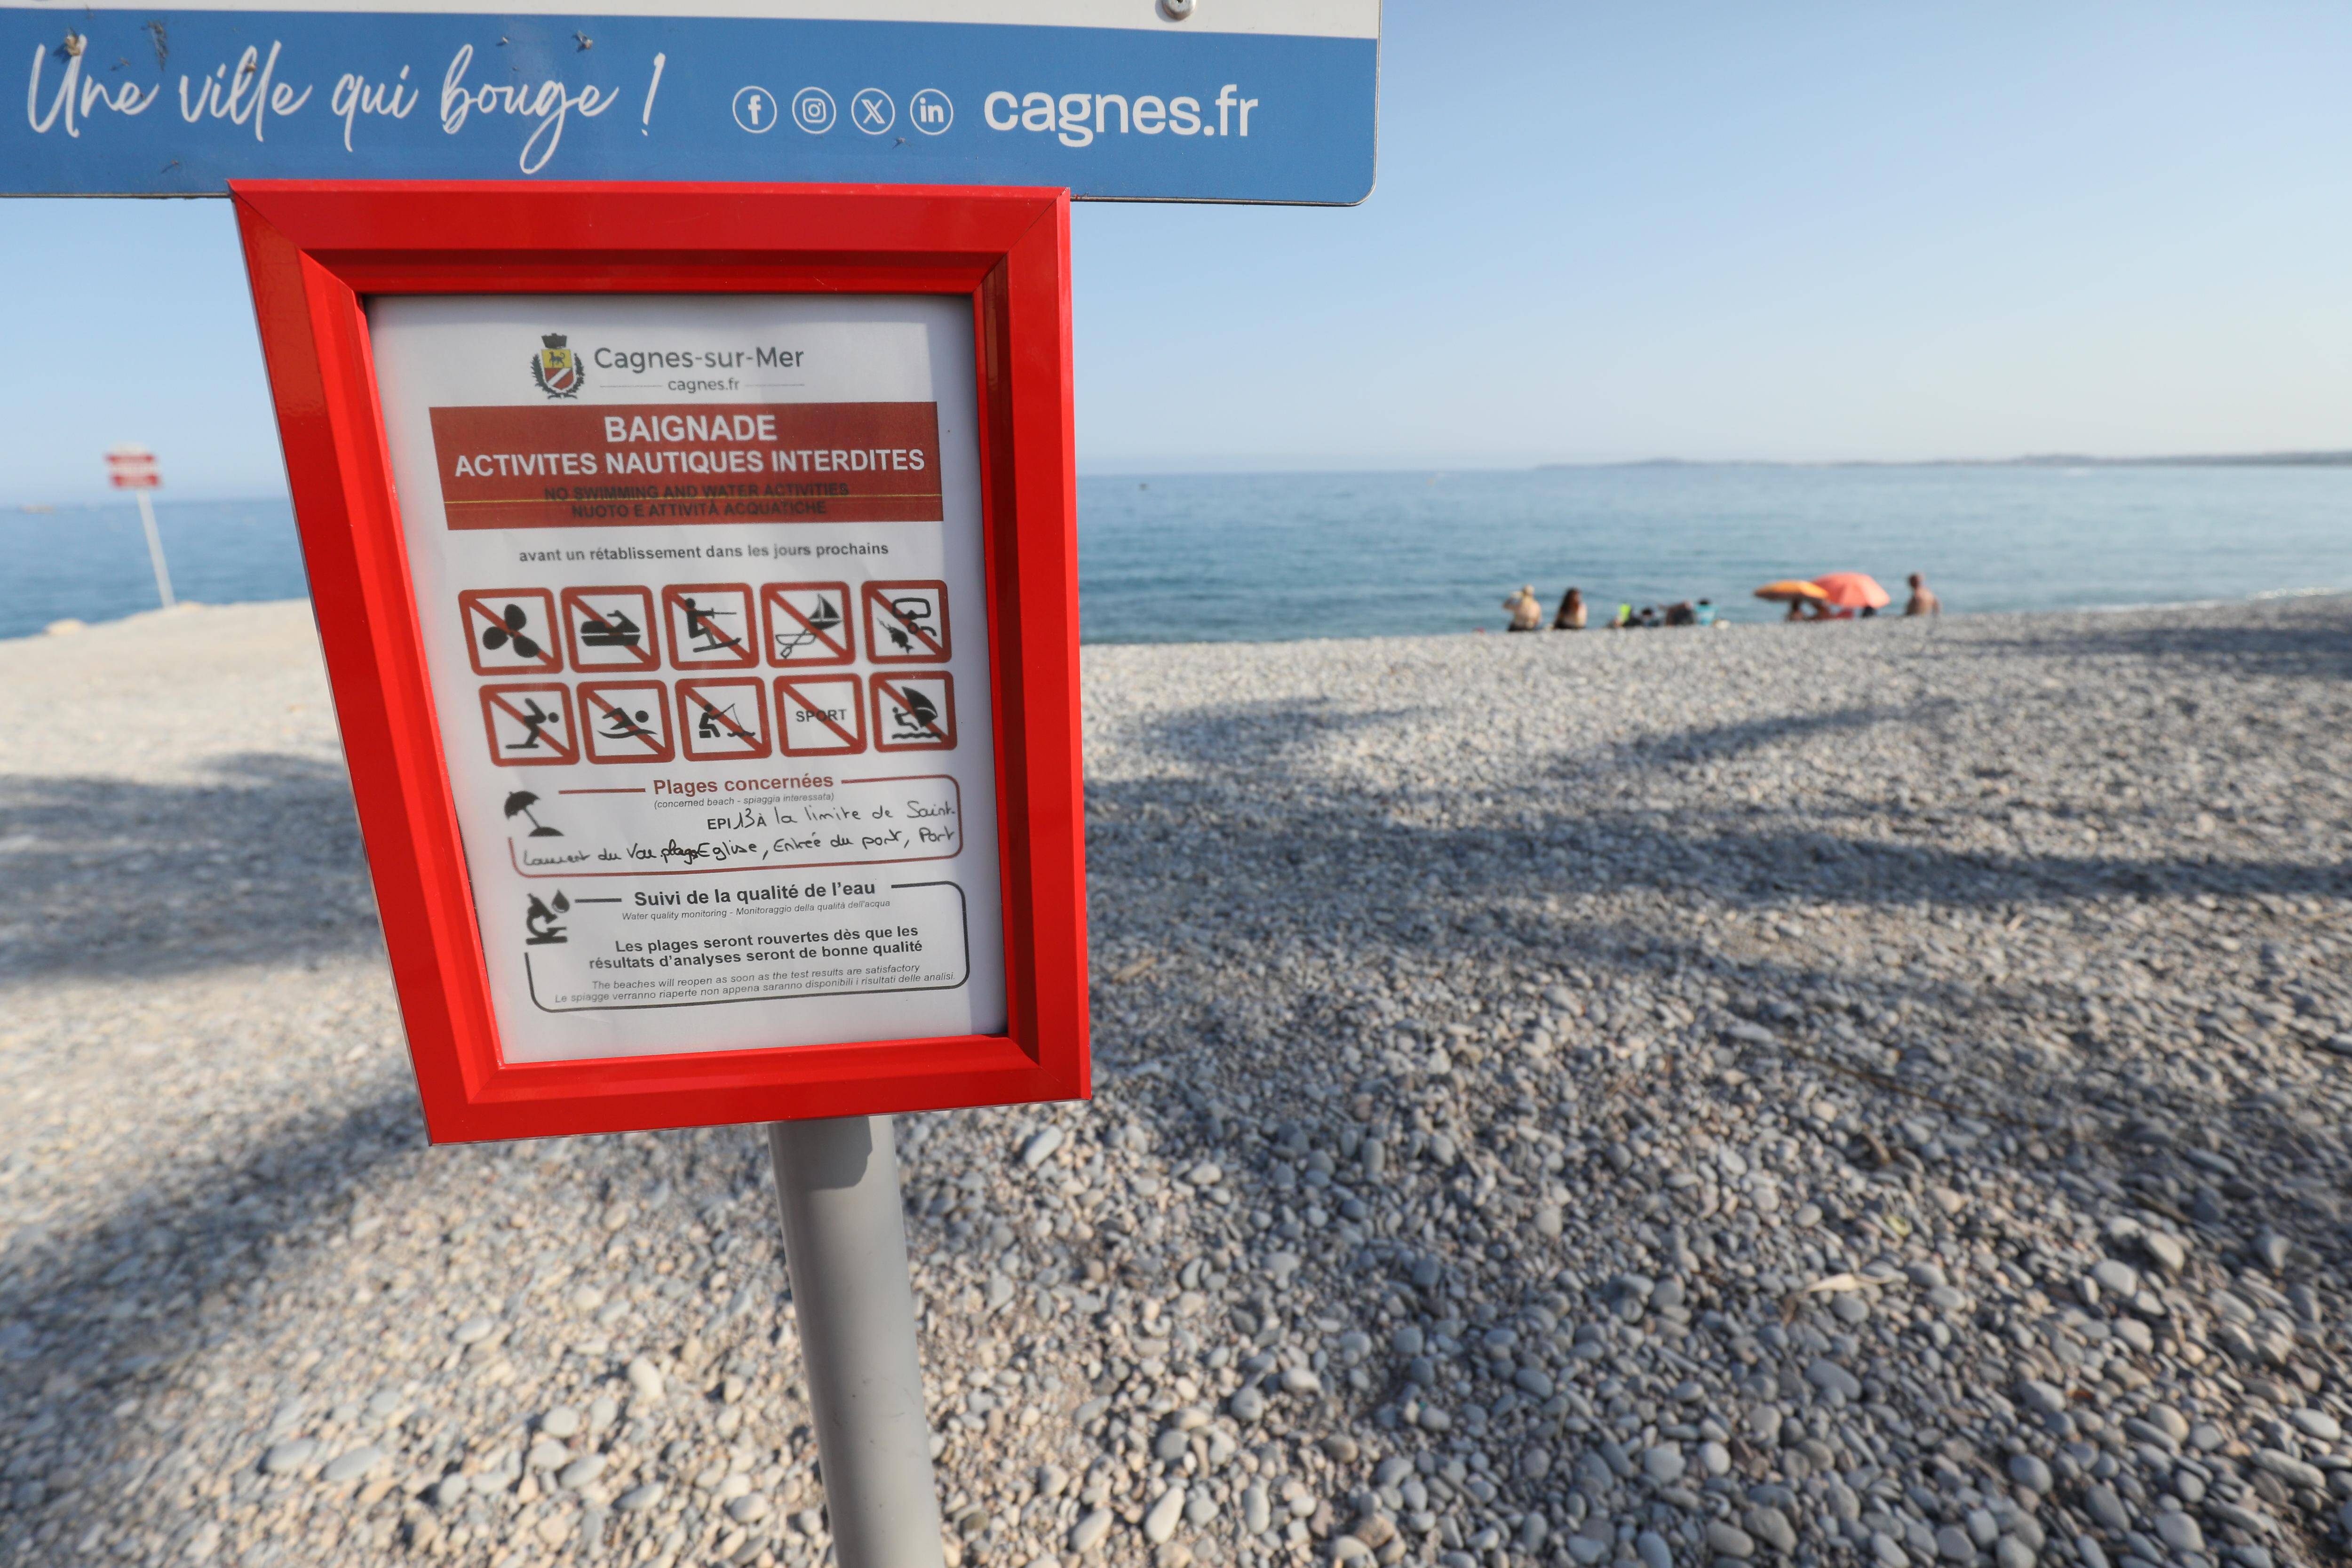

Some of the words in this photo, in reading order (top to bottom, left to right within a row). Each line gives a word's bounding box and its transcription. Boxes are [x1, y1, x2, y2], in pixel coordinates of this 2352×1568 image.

[28, 34, 159, 137] Une
[181, 40, 312, 142] ville
[332, 65, 419, 151] qui
[441, 44, 619, 174] bouge
[641, 52, 666, 136] !
[984, 84, 1258, 148] cagnes.fr
[594, 346, 804, 374] Cagnes-sur-Mer
[668, 378, 740, 394] cagnes.fr
[604, 415, 777, 443] BAIGNADE
[455, 453, 596, 478] ACTIVITES
[607, 450, 763, 475] NAUTIQUES
[772, 449, 924, 472] INTERDITES
[544, 486, 568, 500] NO
[573, 485, 659, 500] SWIMMING
[664, 485, 698, 498] AND
[704, 484, 759, 497] WATER
[764, 483, 850, 496] ACTIVITIES
[572, 504, 628, 517] NUOTO
[635, 504, 644, 517] E
[724, 501, 826, 515] ACQUATICHE
[519, 550, 562, 562] avant
[567, 551, 584, 561] un
[590, 547, 701, 560] rétablissement
[706, 545, 743, 558] dans
[748, 545, 769, 557] les
[774, 545, 810, 559] jours
[816, 543, 889, 558] prochains
[795, 708, 847, 722] SPORT
[653, 779, 718, 797] Plages
[724, 773, 834, 791] concernées
[707, 797, 734, 806] beach
[743, 795, 780, 805] spiaggia
[783, 793, 834, 802] interessata)
[707, 817, 731, 829] EPI
[774, 806, 797, 824] la
[804, 805, 861, 821] limite
[872, 805, 893, 818] de
[830, 834, 854, 847] du
[919, 826, 955, 843] Port
[635, 891, 681, 906] Suivi
[687, 891, 709, 904] de
[715, 889, 731, 903] la
[737, 884, 799, 905] qualité
[805, 883, 826, 898] de
[651, 910, 679, 921] quality
[682, 909, 727, 918] monitoring
[736, 905, 791, 915] Monitoraggio
[795, 904, 814, 912] della
[818, 902, 845, 911] qualità
[615, 941, 643, 952] Les
[648, 939, 699, 954] plages
[704, 935, 753, 948] seront
[757, 931, 829, 945] rouvertes
[834, 929, 860, 940] dès
[865, 928, 892, 941] que
[897, 926, 918, 937] les
[589, 956, 655, 969] résultats
[746, 948, 795, 962] seront
[799, 947, 817, 958] de
[822, 945, 868, 957] bonne
[873, 940, 923, 956] qualité
[555, 995, 567, 1003] Le
[571, 993, 609, 1003] spiagge
[612, 992, 656, 1001] verranno
[659, 988, 697, 999] riaperte
[723, 986, 759, 995] appena
[763, 982, 802, 991] saranno
[805, 978, 853, 989] disponibili
[861, 975, 896, 985] risultati
[898, 973, 921, 983] delle
[924, 972, 955, 981] analisi.
[592, 981, 610, 989] The
[613, 979, 655, 989] beaches
[658, 978, 675, 987] will
[677, 978, 712, 987] reopen
[791, 970, 809, 979] test
[812, 968, 843, 977] results
[865, 964, 920, 975] satisfactory
